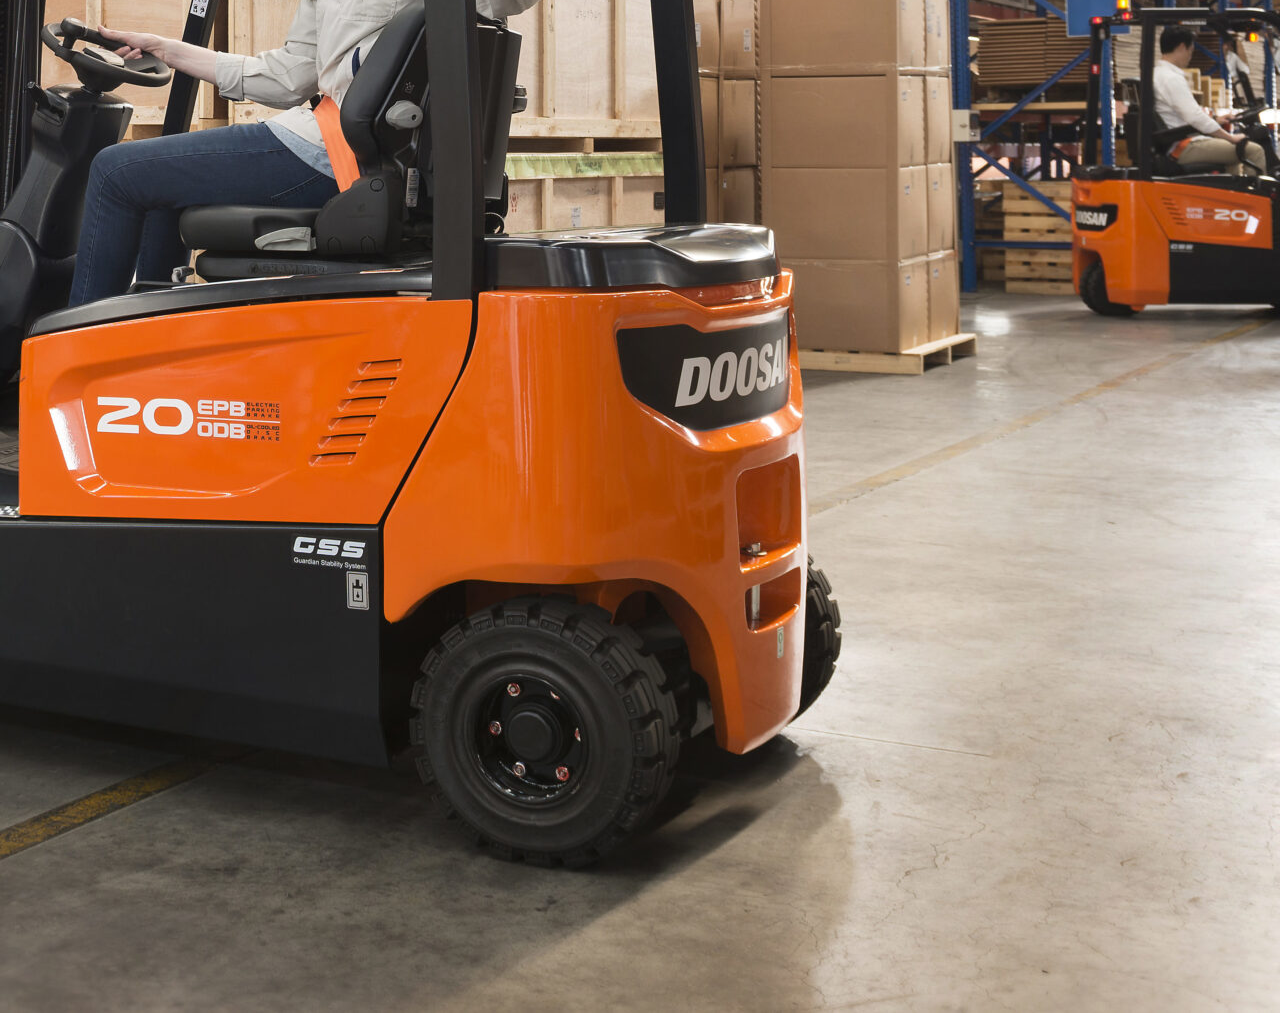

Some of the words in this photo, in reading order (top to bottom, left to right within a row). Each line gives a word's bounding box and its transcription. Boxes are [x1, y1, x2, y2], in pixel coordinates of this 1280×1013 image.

[1214, 208, 1249, 221] 20
[97, 396, 194, 436] 20
[197, 399, 246, 417] EPB
[197, 421, 246, 440] ODB
[293, 536, 366, 558] GSS
[293, 556, 319, 566] Guardian
[320, 559, 343, 569] Stability
[344, 562, 367, 570] System
